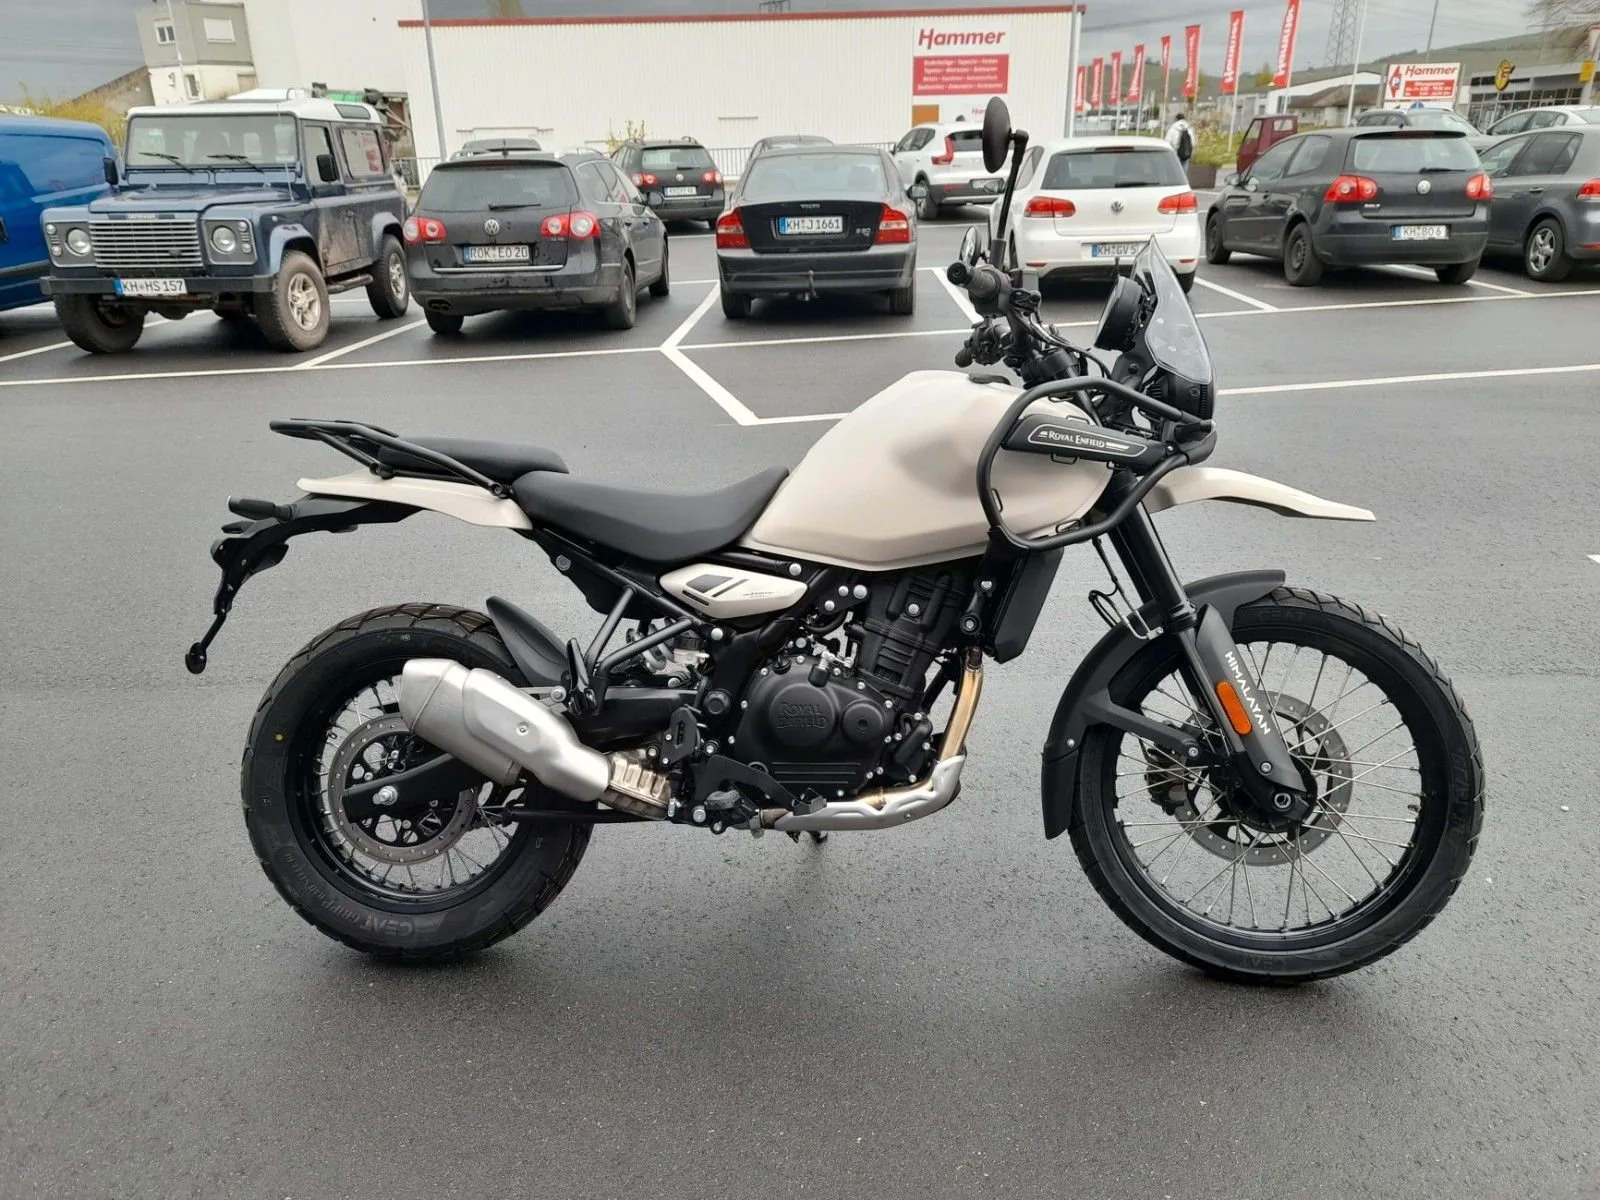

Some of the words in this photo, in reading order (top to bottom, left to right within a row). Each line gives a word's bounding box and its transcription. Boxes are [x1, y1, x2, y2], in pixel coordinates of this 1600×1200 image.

[918, 28, 1006, 50] Hammer
[1405, 65, 1458, 77] Hammer
[787, 220, 800, 230] KH
[816, 219, 841, 230] 1661
[1404, 226, 1416, 236] KH
[470, 246, 491, 259] ROK
[514, 246, 528, 258] 20
[1097, 244, 1110, 255] KH
[1116, 244, 1129, 255] GV
[123, 281, 139, 292] KH
[145, 281, 161, 291] HS
[163, 281, 183, 292] 157
[1048, 430, 1074, 443] ROYAL
[1075, 434, 1105, 448] ENFIELD
[1225, 651, 1271, 735] HIMALAYAN
